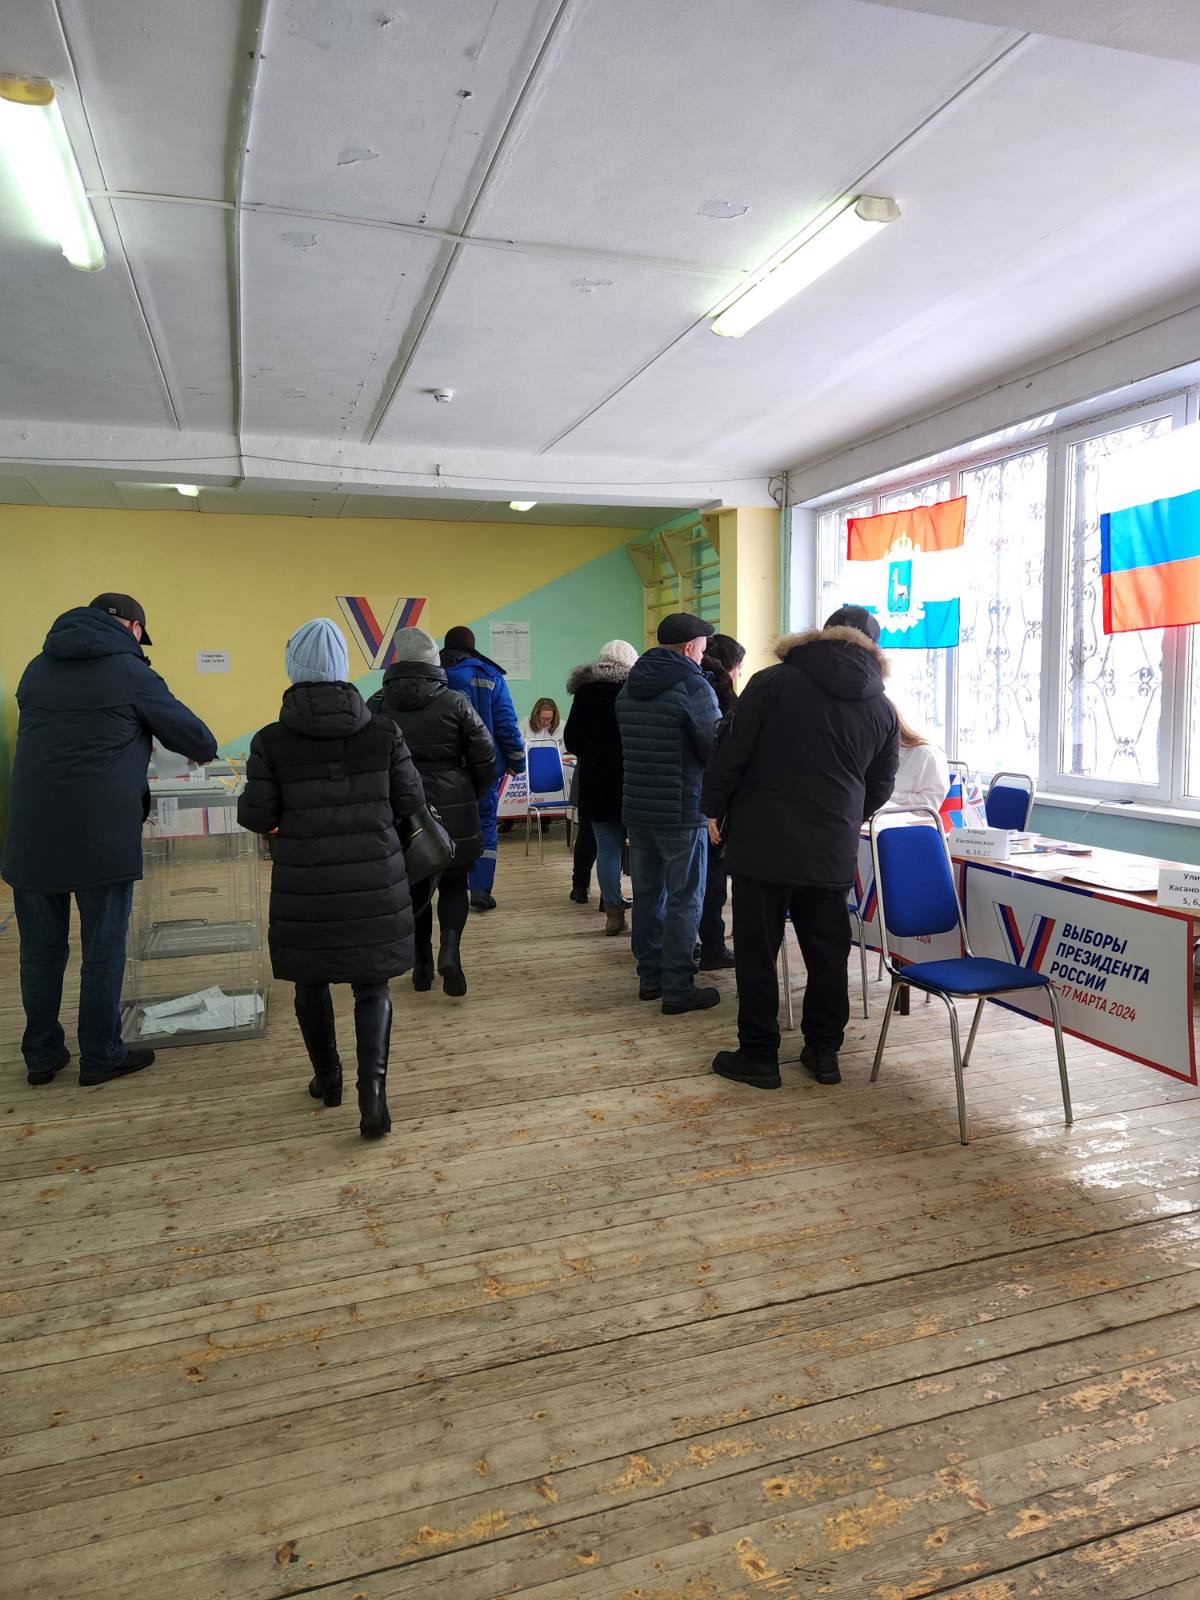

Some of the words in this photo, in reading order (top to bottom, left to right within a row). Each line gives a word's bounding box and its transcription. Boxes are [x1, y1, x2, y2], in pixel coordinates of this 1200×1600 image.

[1062, 923, 1128, 954] ВЫБОРЫ
[1050, 961, 1107, 992] РОССИИ
[1056, 942, 1150, 984] ПРЕЗИДЕНТА
[1050, 980, 1072, 998] 5–17
[1072, 988, 1108, 1012] МАРТА
[1108, 1001, 1136, 1022] 2024
